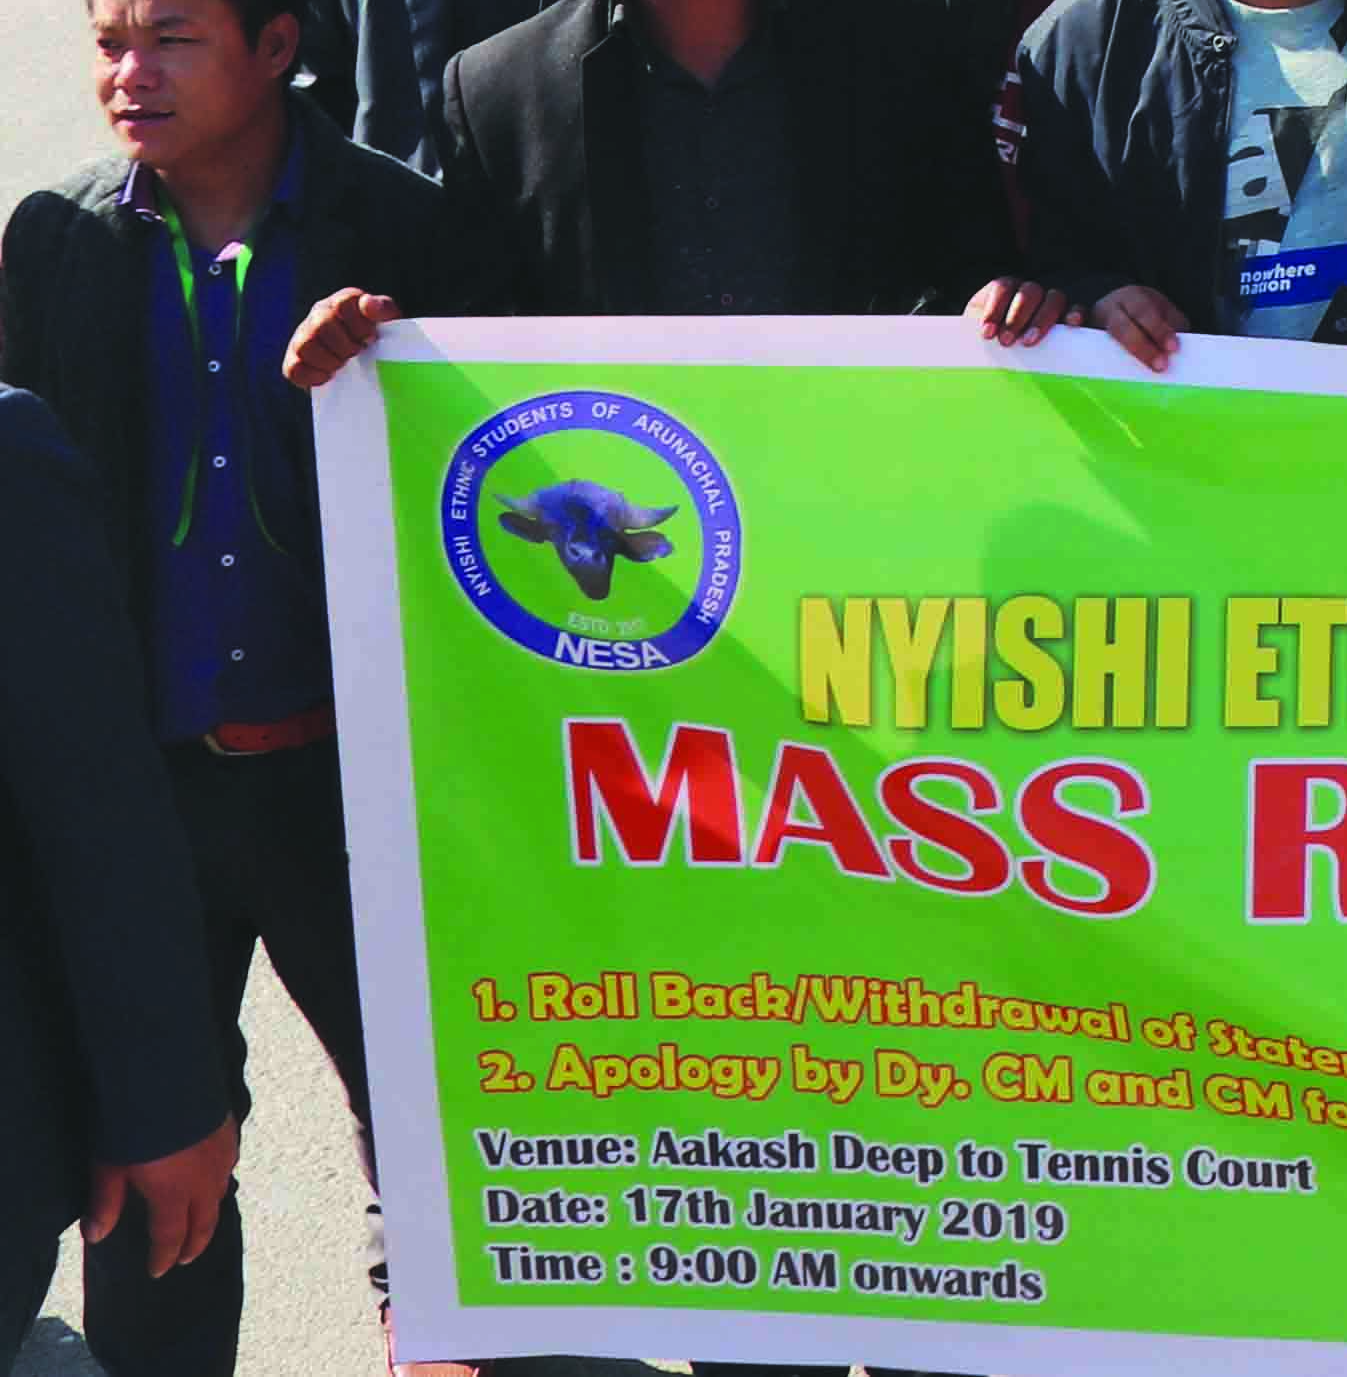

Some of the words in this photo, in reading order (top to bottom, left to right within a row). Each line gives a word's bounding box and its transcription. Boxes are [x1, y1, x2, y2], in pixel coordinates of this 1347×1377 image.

[1240, 262, 1317, 283] nowhere
[1240, 279, 1292, 296] nation
[471, 400, 575, 459] STUDENTS
[591, 400, 622, 420] OF
[449, 460, 477, 522] ETHNIC
[632, 412, 727, 516] ARUNACHAL
[452, 534, 492, 598] NYISHI
[695, 528, 732, 626] PRADESH
[553, 630, 672, 671] NESA
[797, 592, 1195, 734] NYISHI
[562, 716, 1157, 921] MASS
[472, 978, 517, 1021] 1.
[528, 972, 638, 1021] Roll
[650, 972, 1130, 1043] Back/Withdrawal
[1141, 1009, 1196, 1051] of
[478, 1049, 536, 1094] 2.
[545, 1041, 782, 1100] Apology
[792, 1044, 865, 1104] by
[873, 1048, 972, 1109] Dy.
[981, 1051, 1075, 1104] CM
[1086, 1067, 1194, 1111] and
[1202, 1075, 1294, 1121] CM
[476, 1127, 638, 1171] Venue:
[650, 1129, 817, 1175] Aakash
[832, 1129, 945, 1184] Deep
[957, 1137, 1006, 1180] to
[1016, 1139, 1173, 1189] Tennis
[1184, 1148, 1316, 1194] Court
[485, 1188, 608, 1228] Date:
[624, 1187, 732, 1230] 17th
[744, 1189, 928, 1244] January
[940, 1198, 1067, 1244] 2019
[489, 1244, 602, 1285] Time
[648, 1245, 759, 1290] 9:00
[770, 1249, 838, 1292] AM
[852, 1257, 1045, 1304] onwards
